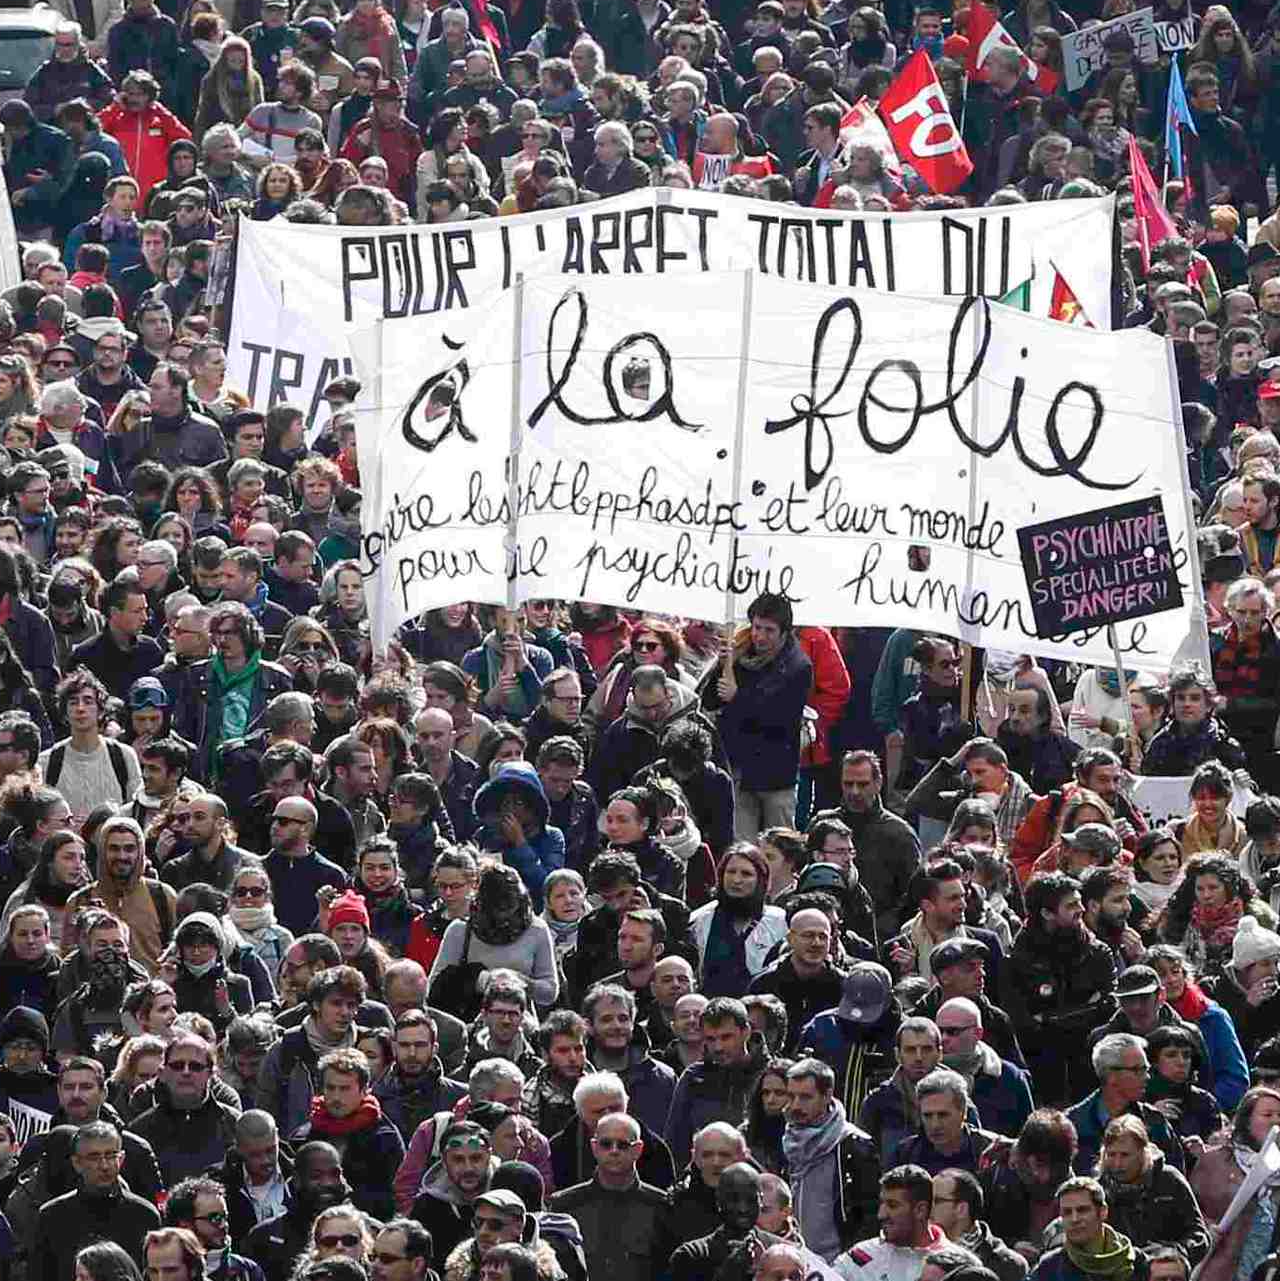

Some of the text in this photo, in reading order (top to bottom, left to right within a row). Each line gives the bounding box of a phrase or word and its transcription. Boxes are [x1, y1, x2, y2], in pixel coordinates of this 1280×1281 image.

[1156, 22, 1198, 50] NON
[891, 83, 961, 157] FO
[341, 228, 477, 322] POUR
[942, 216, 1010, 297] DU
[402, 286, 1150, 492] à la folie
[459, 468, 512, 528] les
[760, 480, 810, 535] et
[817, 475, 897, 536] leur
[901, 502, 1005, 558] monde
[1031, 507, 1170, 577] PSYCHIATRIE
[393, 547, 494, 612] pour
[571, 531, 807, 604] psychiatrie
